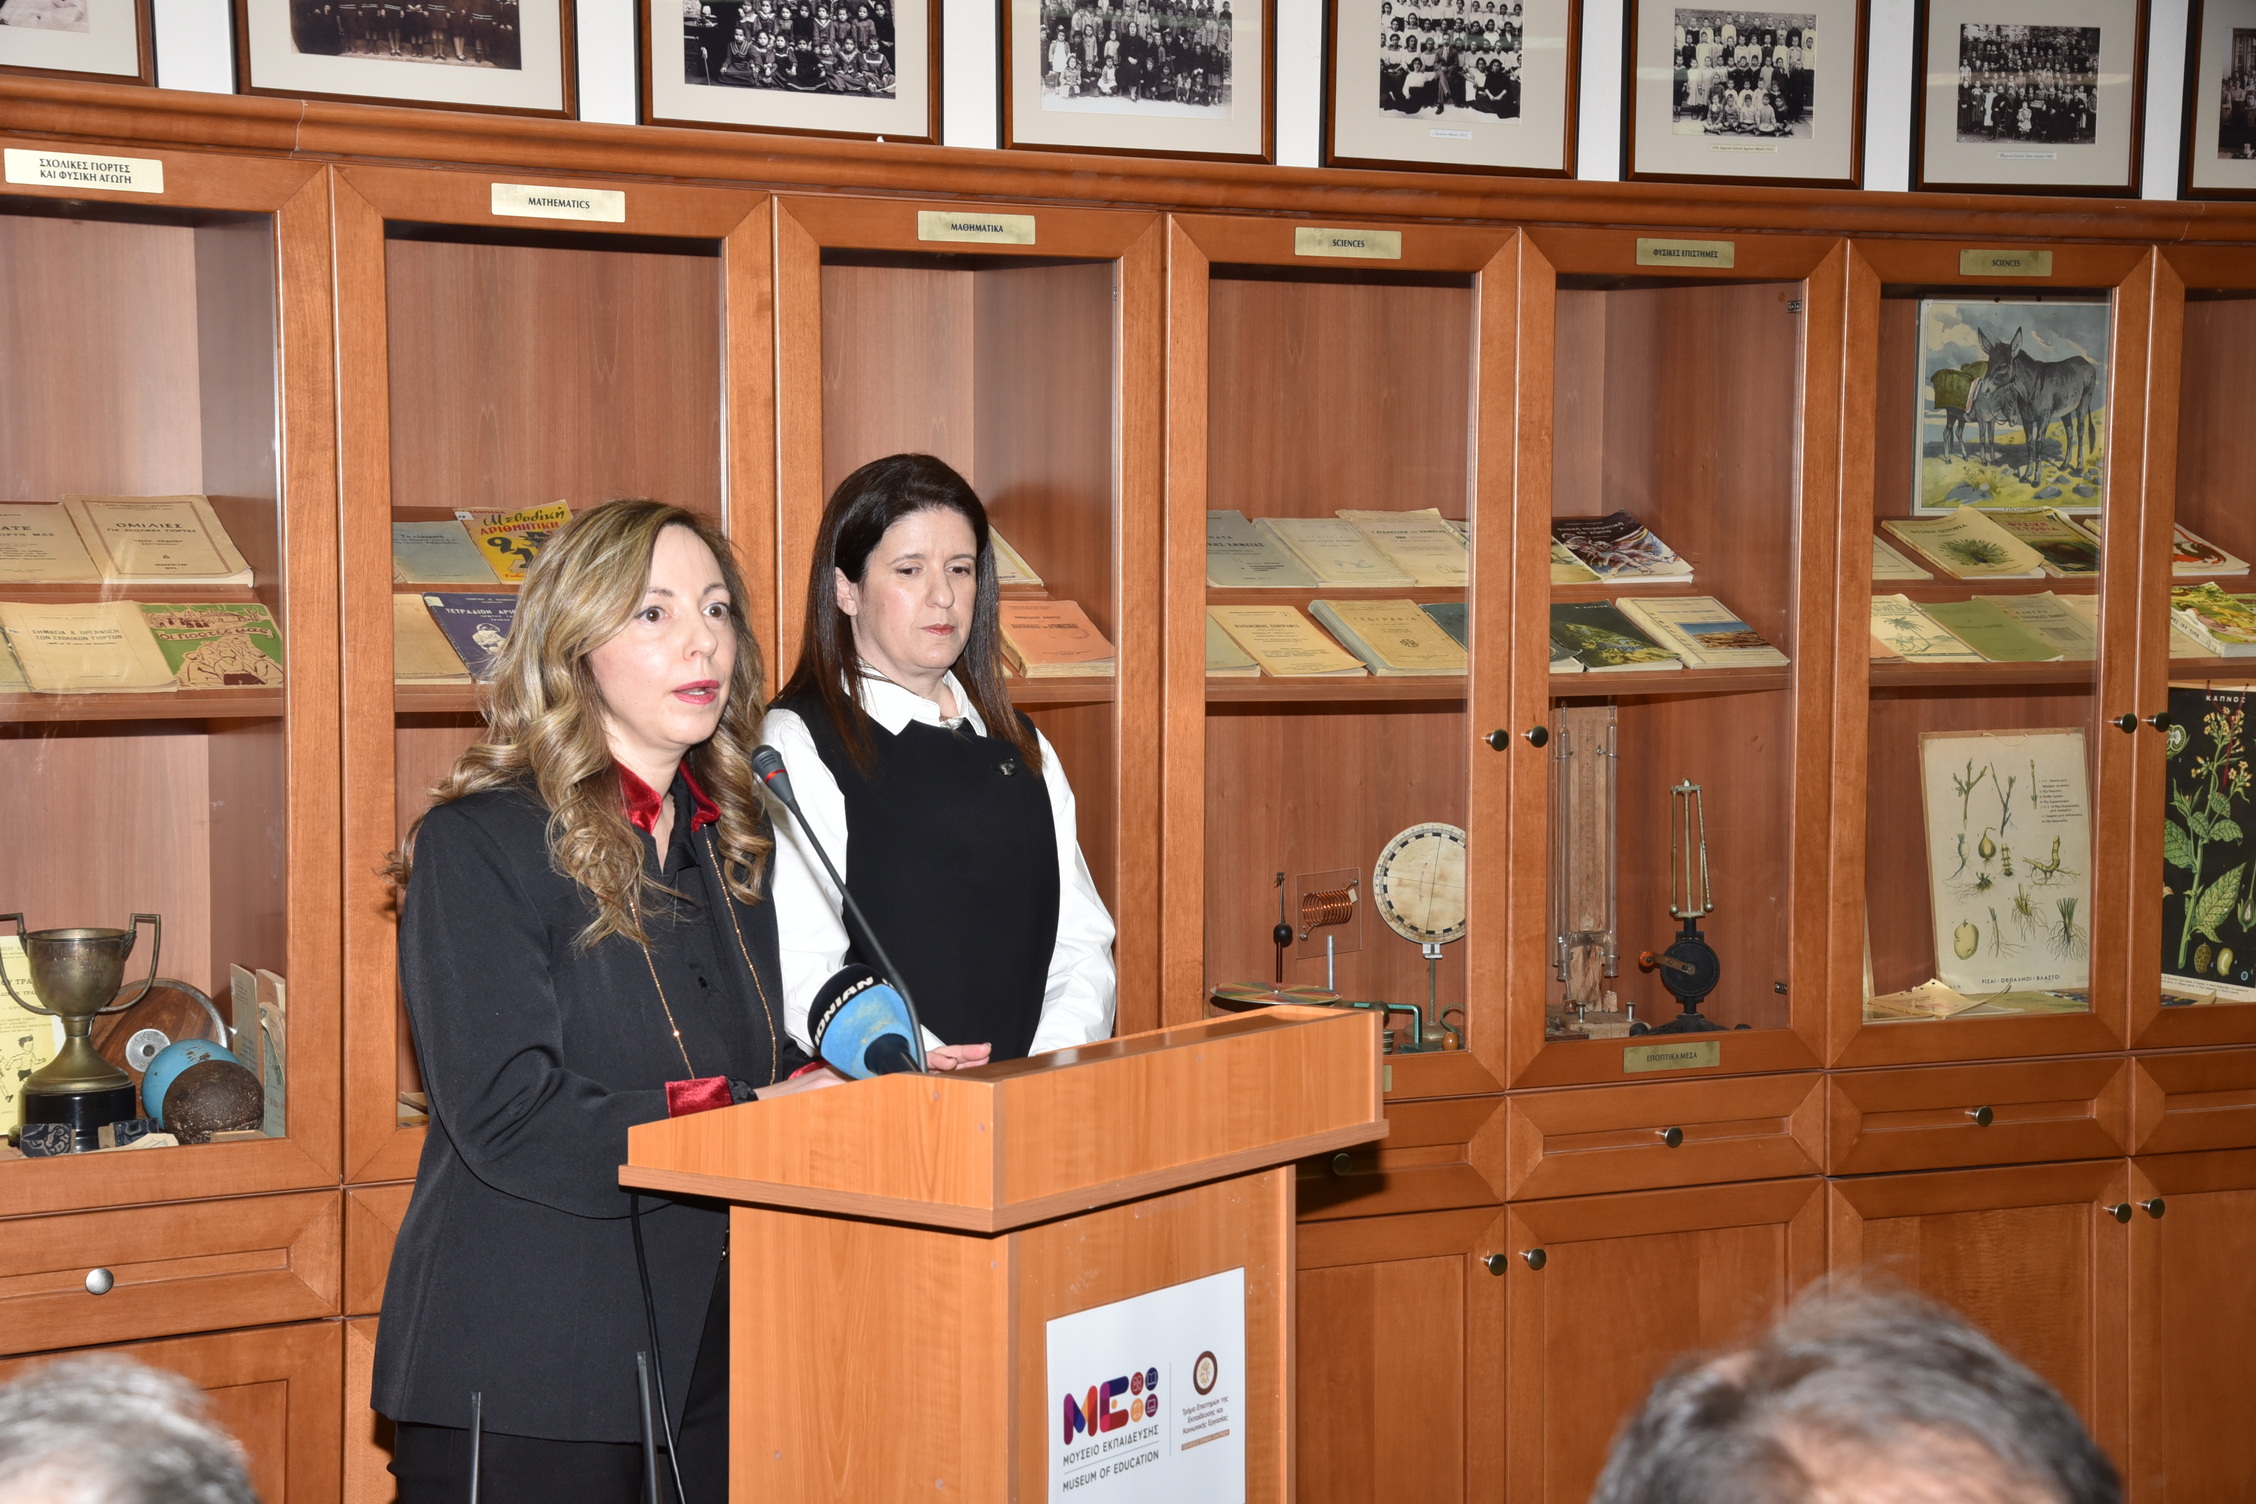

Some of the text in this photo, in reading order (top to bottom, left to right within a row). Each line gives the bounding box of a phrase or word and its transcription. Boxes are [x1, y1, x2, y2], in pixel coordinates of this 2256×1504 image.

[39, 158, 131, 174] ΣΧΟΛΙΚΕΣ ΓΙΟΡΤΕΣ
[40, 169, 132, 184] ΚΑΙ ΦΥΣΙΚΗ ΑΓΩΓΗ
[528, 197, 590, 209] MATHEMATICS
[950, 223, 1004, 233] ΜΑΘΗΜΑΤΙΚΑ
[1332, 238, 1365, 248] SCIENCES
[1653, 248, 1719, 258] ΦΥΣΙΚΕΣ ΕΠΙΣΤΗΜΕΣ
[1992, 259, 2021, 267] SCIENCES
[480, 521, 559, 535] ΑΡΙΘΜΗΤΙΚΗ
[445, 607, 493, 615] ΤΕΤΡΑΔΙΟΝ
[2205, 694, 2246, 703] ΚΑΠΝΟΣ
[814, 976, 874, 1046] IONIAN
[1646, 1052, 1698, 1062] ΕΠΟΠΤΙΚΑ ΜΕΣΑ
[1063, 1444, 1100, 1467] ΜΟΥΣΕΙΟ
[1102, 1424, 1159, 1453] ΕΚΠΑΙΔΕΥΣΗΣ
[1062, 1450, 1159, 1493] MUSEUM OF EDUCATION
